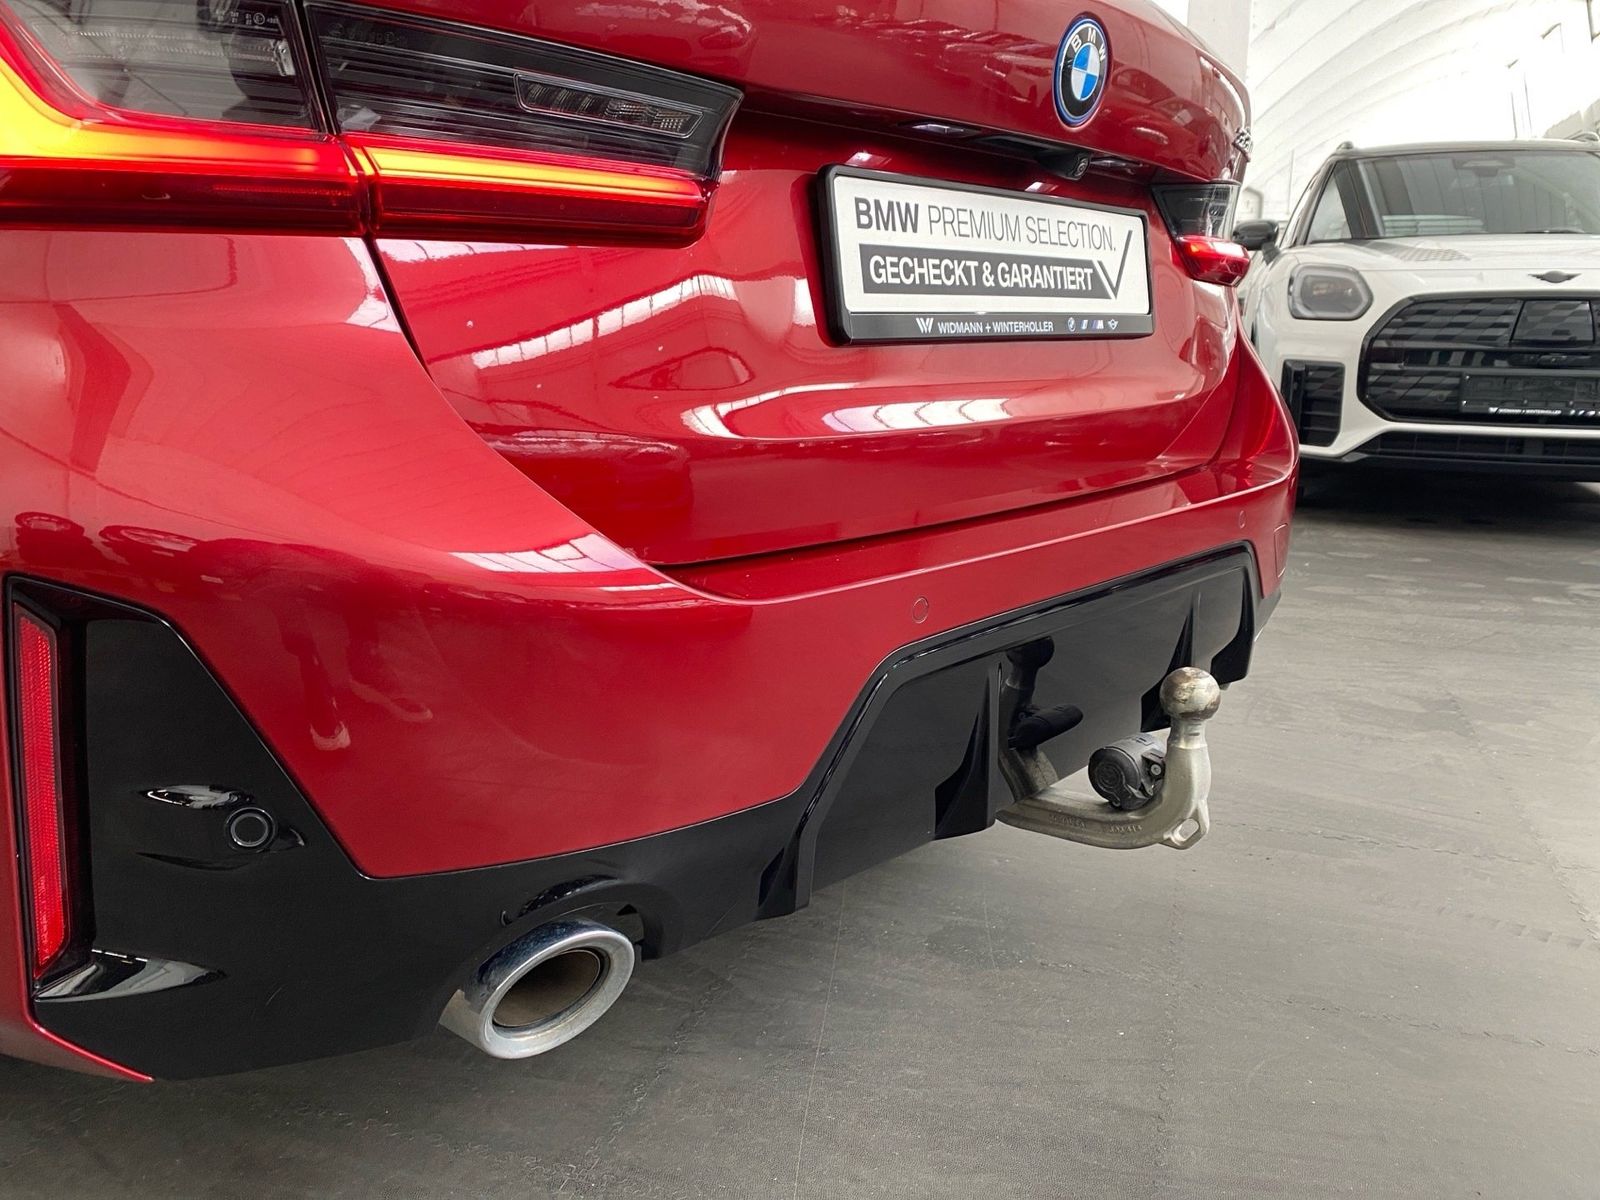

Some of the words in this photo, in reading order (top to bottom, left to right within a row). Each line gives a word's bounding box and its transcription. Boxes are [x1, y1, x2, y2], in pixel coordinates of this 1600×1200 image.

[1070, 27, 1107, 62] BMW
[854, 196, 920, 233] BMW
[928, 205, 1022, 242] PREMIUM
[1026, 215, 1117, 251] SELECTION.
[869, 254, 979, 286] GECHECKT
[982, 262, 995, 287] &
[997, 261, 1094, 291] GARANTIERT
[937, 322, 983, 334] WIDMANN
[985, 323, 992, 333] +
[992, 321, 1054, 334] WINTERHOLLER
